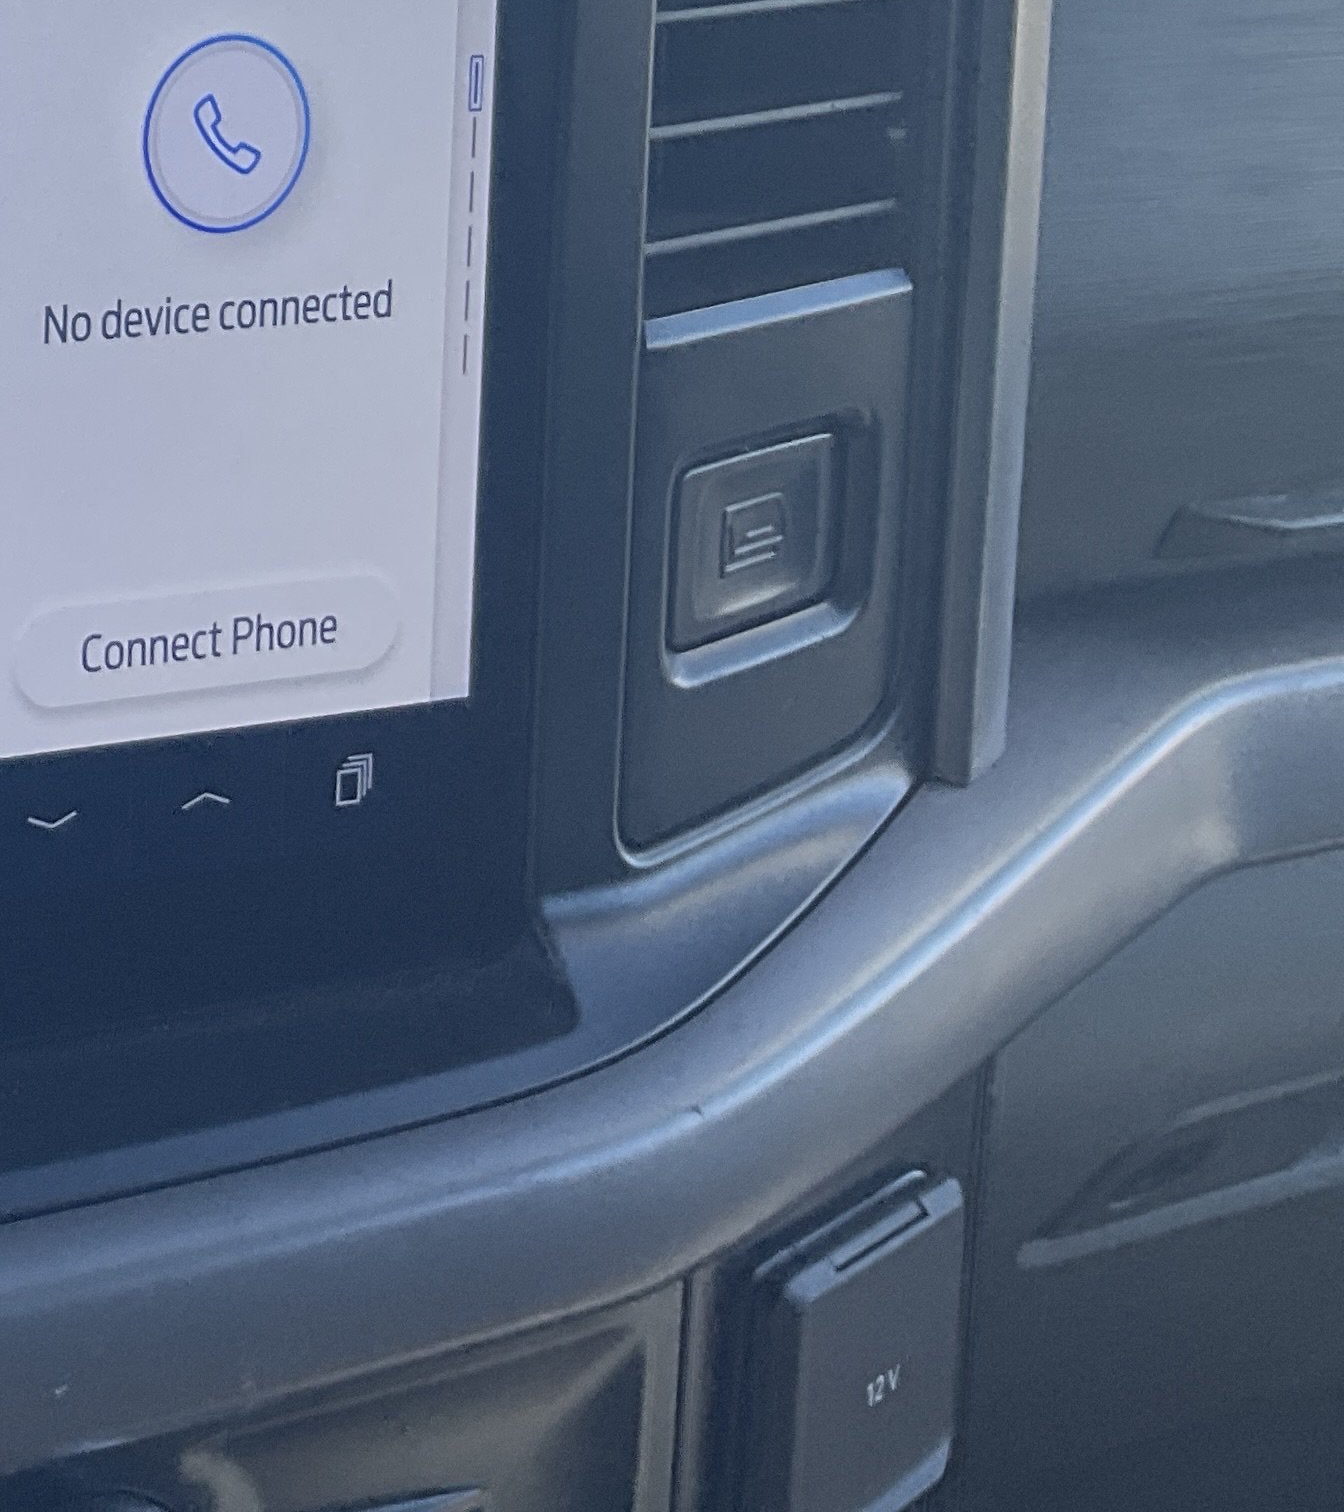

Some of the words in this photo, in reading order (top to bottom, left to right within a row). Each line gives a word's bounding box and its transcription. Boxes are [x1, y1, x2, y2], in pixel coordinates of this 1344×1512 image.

[42, 303, 93, 345] No
[100, 297, 211, 340] device
[218, 278, 394, 331] connected
[80, 622, 222, 673] Connect
[231, 613, 338, 656] Phone
[866, 1363, 901, 1407] 12V
